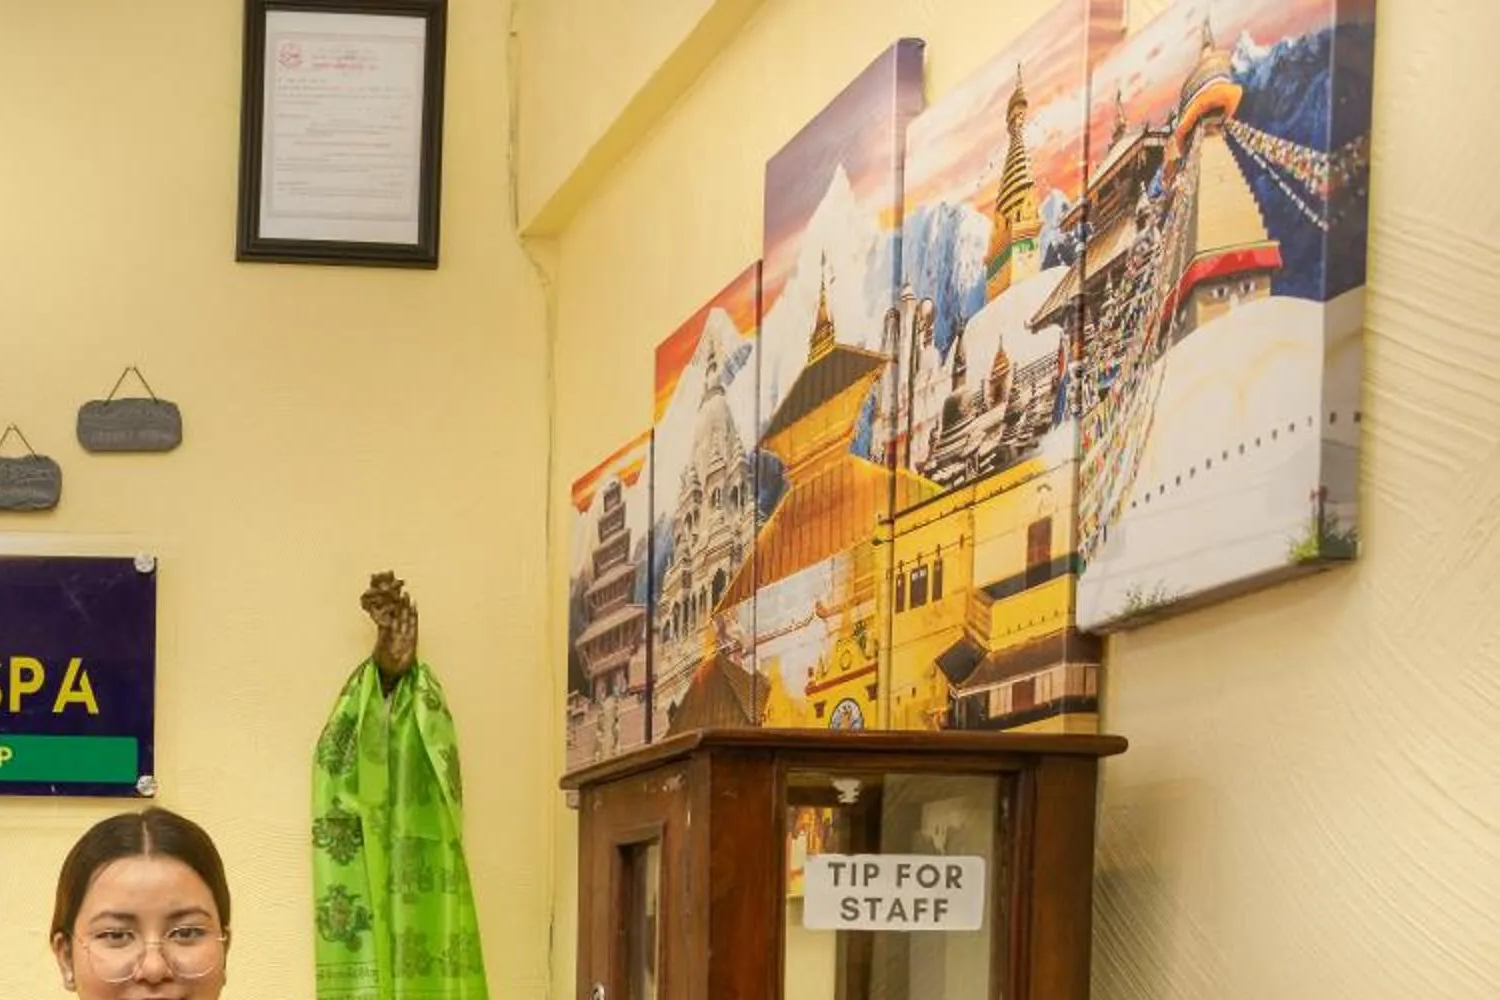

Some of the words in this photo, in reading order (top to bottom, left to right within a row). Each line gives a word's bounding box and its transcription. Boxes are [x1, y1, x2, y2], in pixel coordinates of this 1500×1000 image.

[828, 862, 880, 887] TIP
[896, 863, 963, 889] FOR
[840, 896, 949, 923] STAFF
